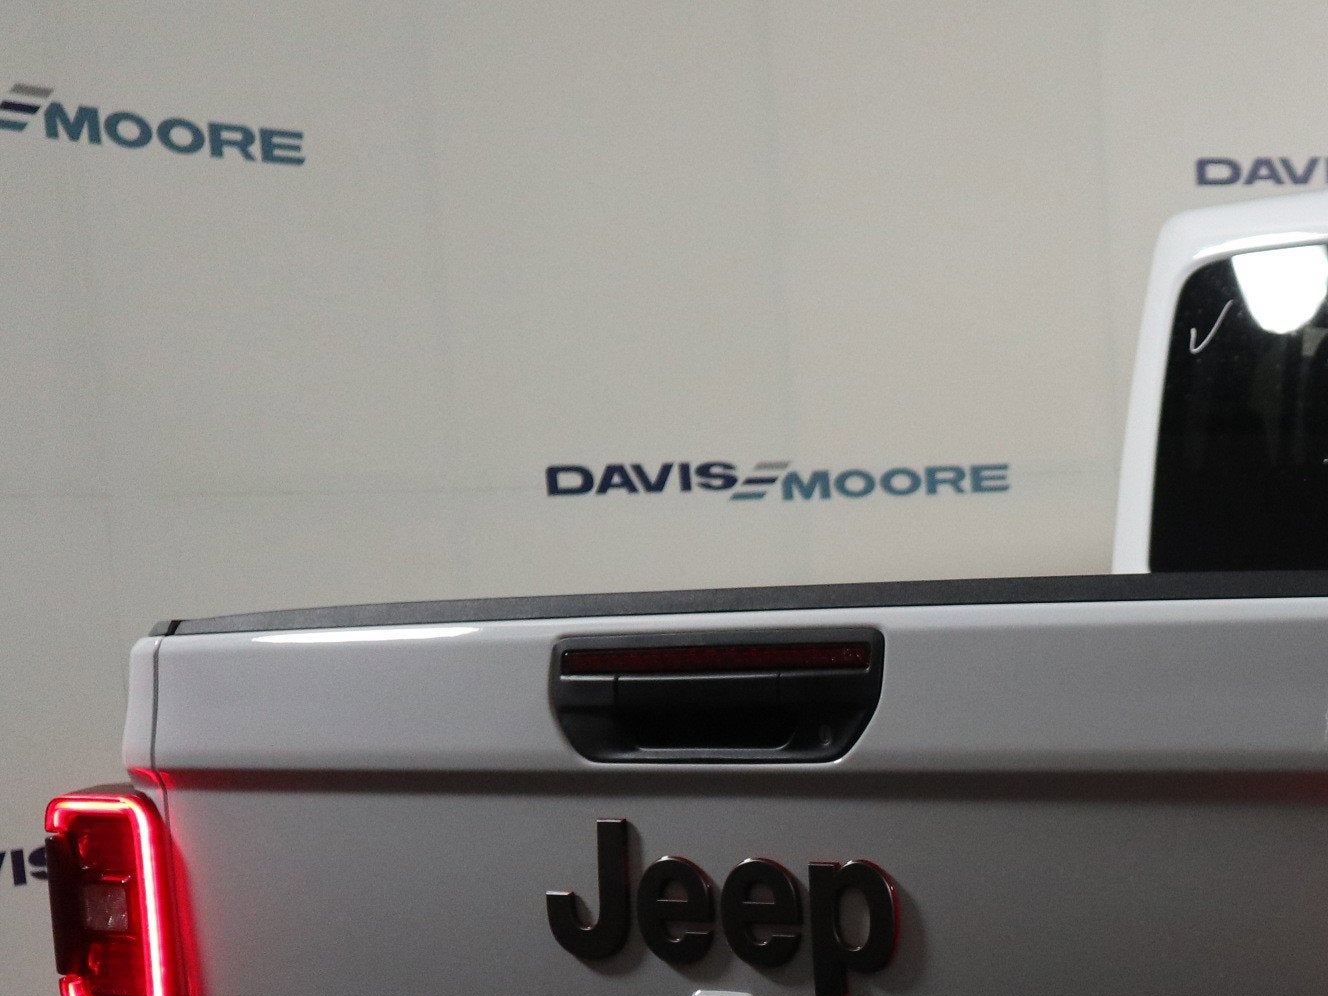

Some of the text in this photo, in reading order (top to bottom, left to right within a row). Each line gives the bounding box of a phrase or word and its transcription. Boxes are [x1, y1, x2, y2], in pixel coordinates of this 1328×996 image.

[43, 101, 305, 166] MOORE
[546, 461, 1010, 501] DAVIS MOORE
